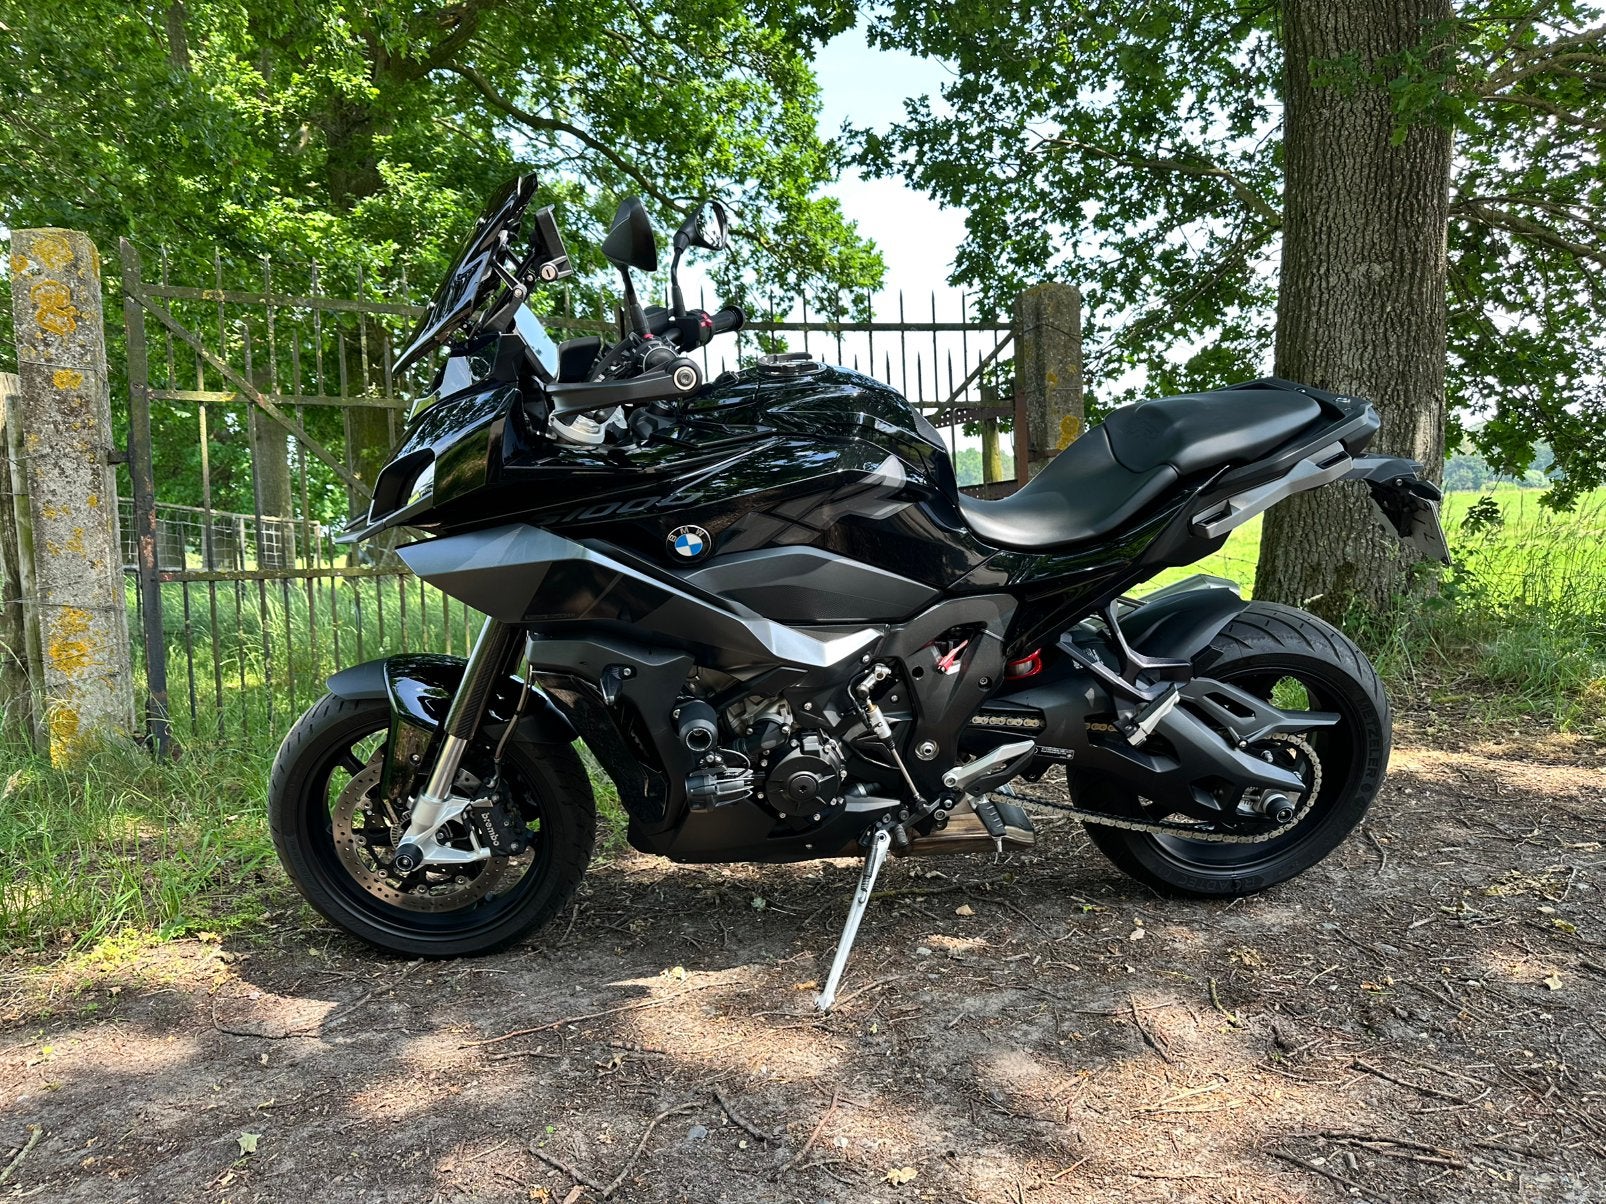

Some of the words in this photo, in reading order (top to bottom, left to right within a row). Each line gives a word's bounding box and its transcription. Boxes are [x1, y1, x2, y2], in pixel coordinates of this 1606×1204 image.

[667, 526, 707, 544] BMW
[1356, 698, 1381, 779] METZELER
[481, 811, 500, 847] brembo
